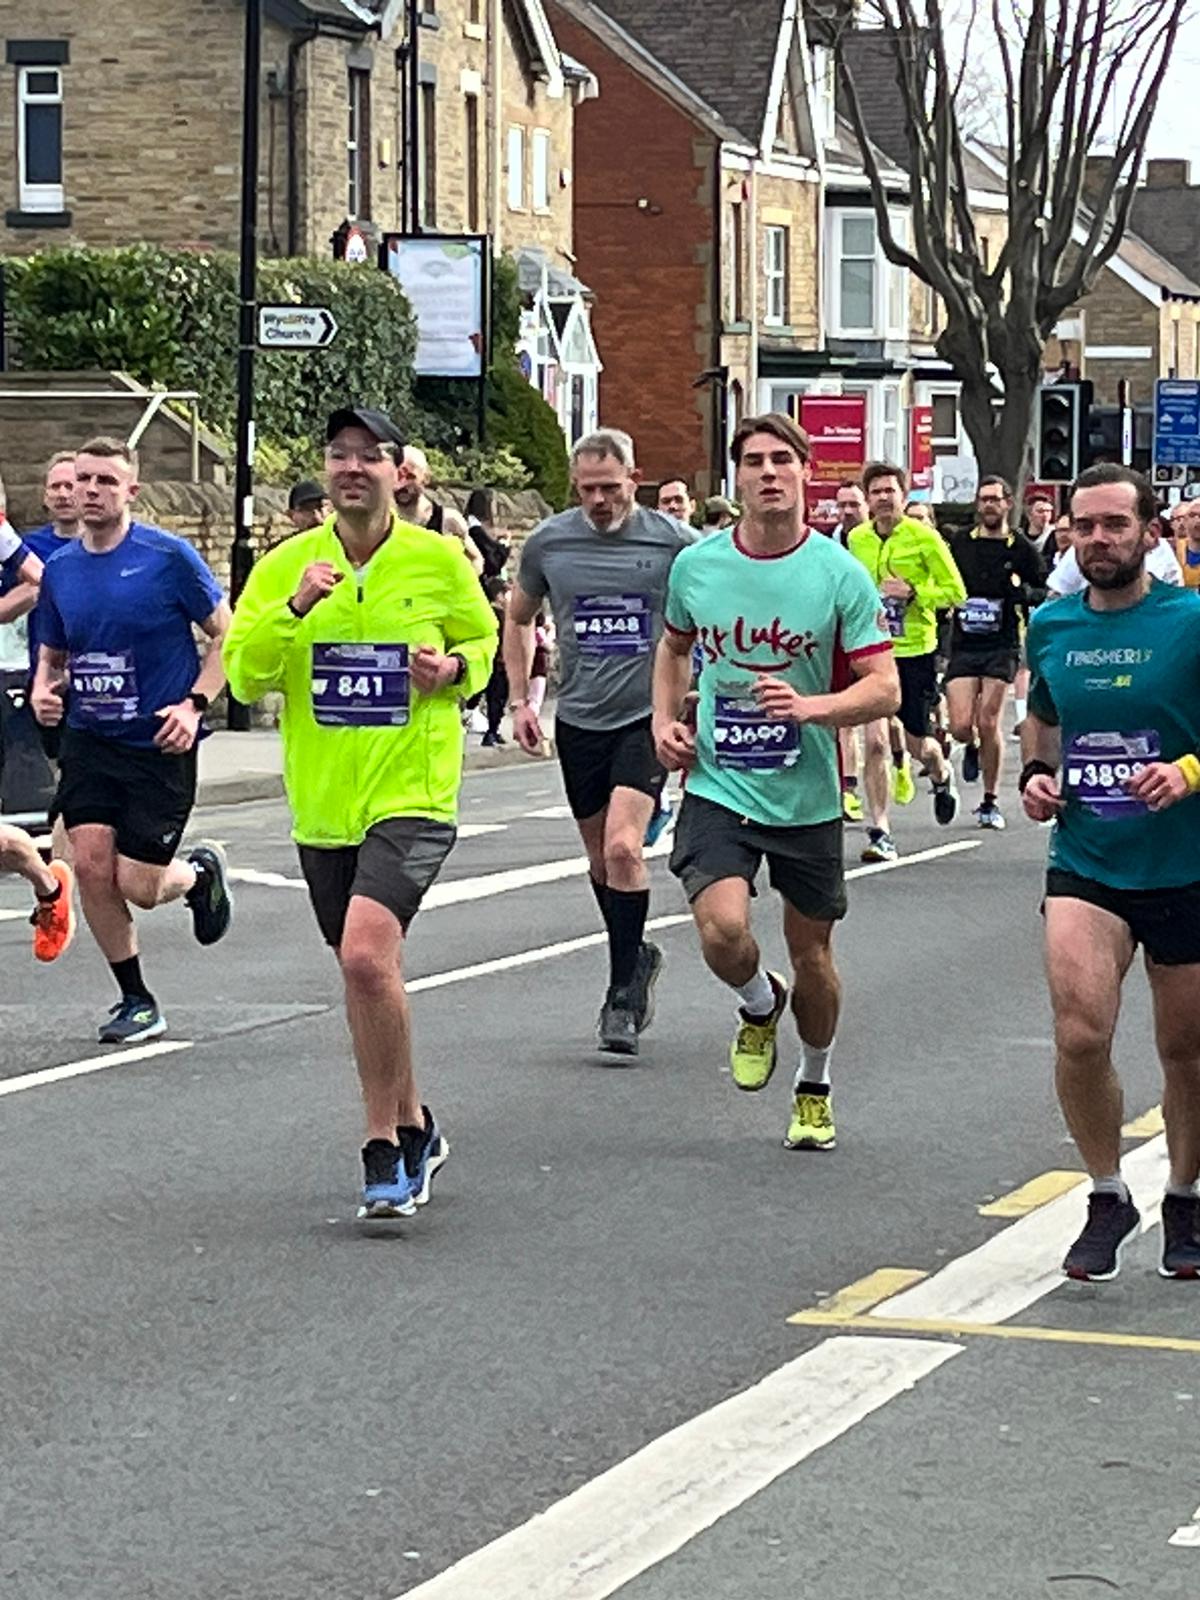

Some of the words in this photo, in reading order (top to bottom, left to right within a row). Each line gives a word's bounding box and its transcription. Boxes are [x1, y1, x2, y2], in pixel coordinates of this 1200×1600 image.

[266, 327, 312, 340] Church
[588, 616, 640, 633] 4548
[84, 675, 125, 692] 1079
[338, 675, 383, 697] 841
